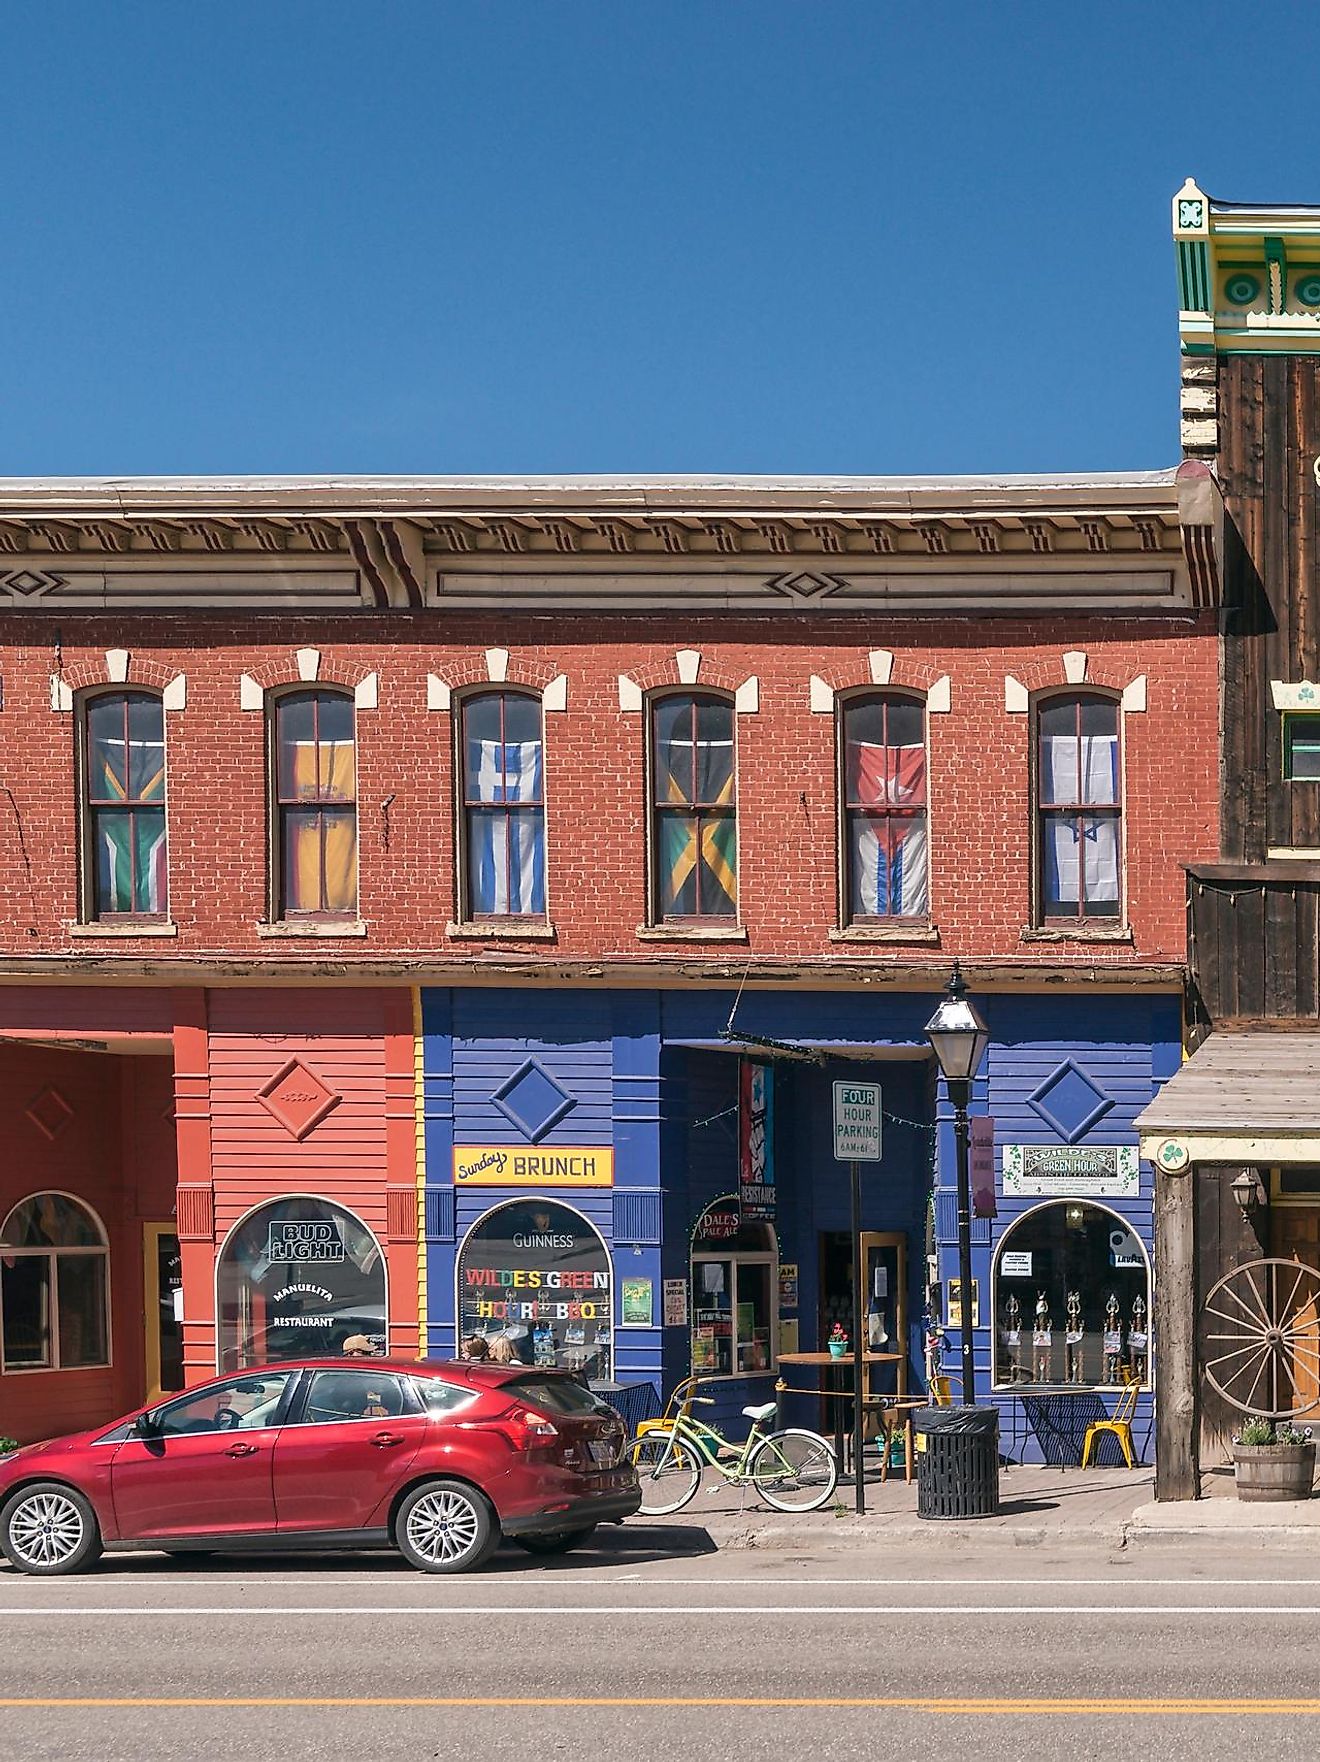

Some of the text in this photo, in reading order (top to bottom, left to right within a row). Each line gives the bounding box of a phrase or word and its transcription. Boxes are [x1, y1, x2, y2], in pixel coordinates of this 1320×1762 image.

[842, 1090, 874, 1104] FOUR
[844, 1109, 872, 1121] HOUR
[837, 1125, 878, 1138] PARKING
[458, 1152, 596, 1179] Sunday BRUNCH
[1043, 1161, 1098, 1172] GREEN HOUR
[704, 1213, 739, 1226] DALE'S
[283, 1225, 332, 1242] BUD
[702, 1227, 738, 1238] PALE ALE
[513, 1232, 573, 1248] GUINNESS
[272, 1242, 341, 1260] LIGHT
[467, 1269, 608, 1289] WILDES GREEN
[273, 1283, 334, 1302] MANUELITA
[274, 1318, 334, 1328] RESTAURANT
[964, 1344, 970, 1355] 3
